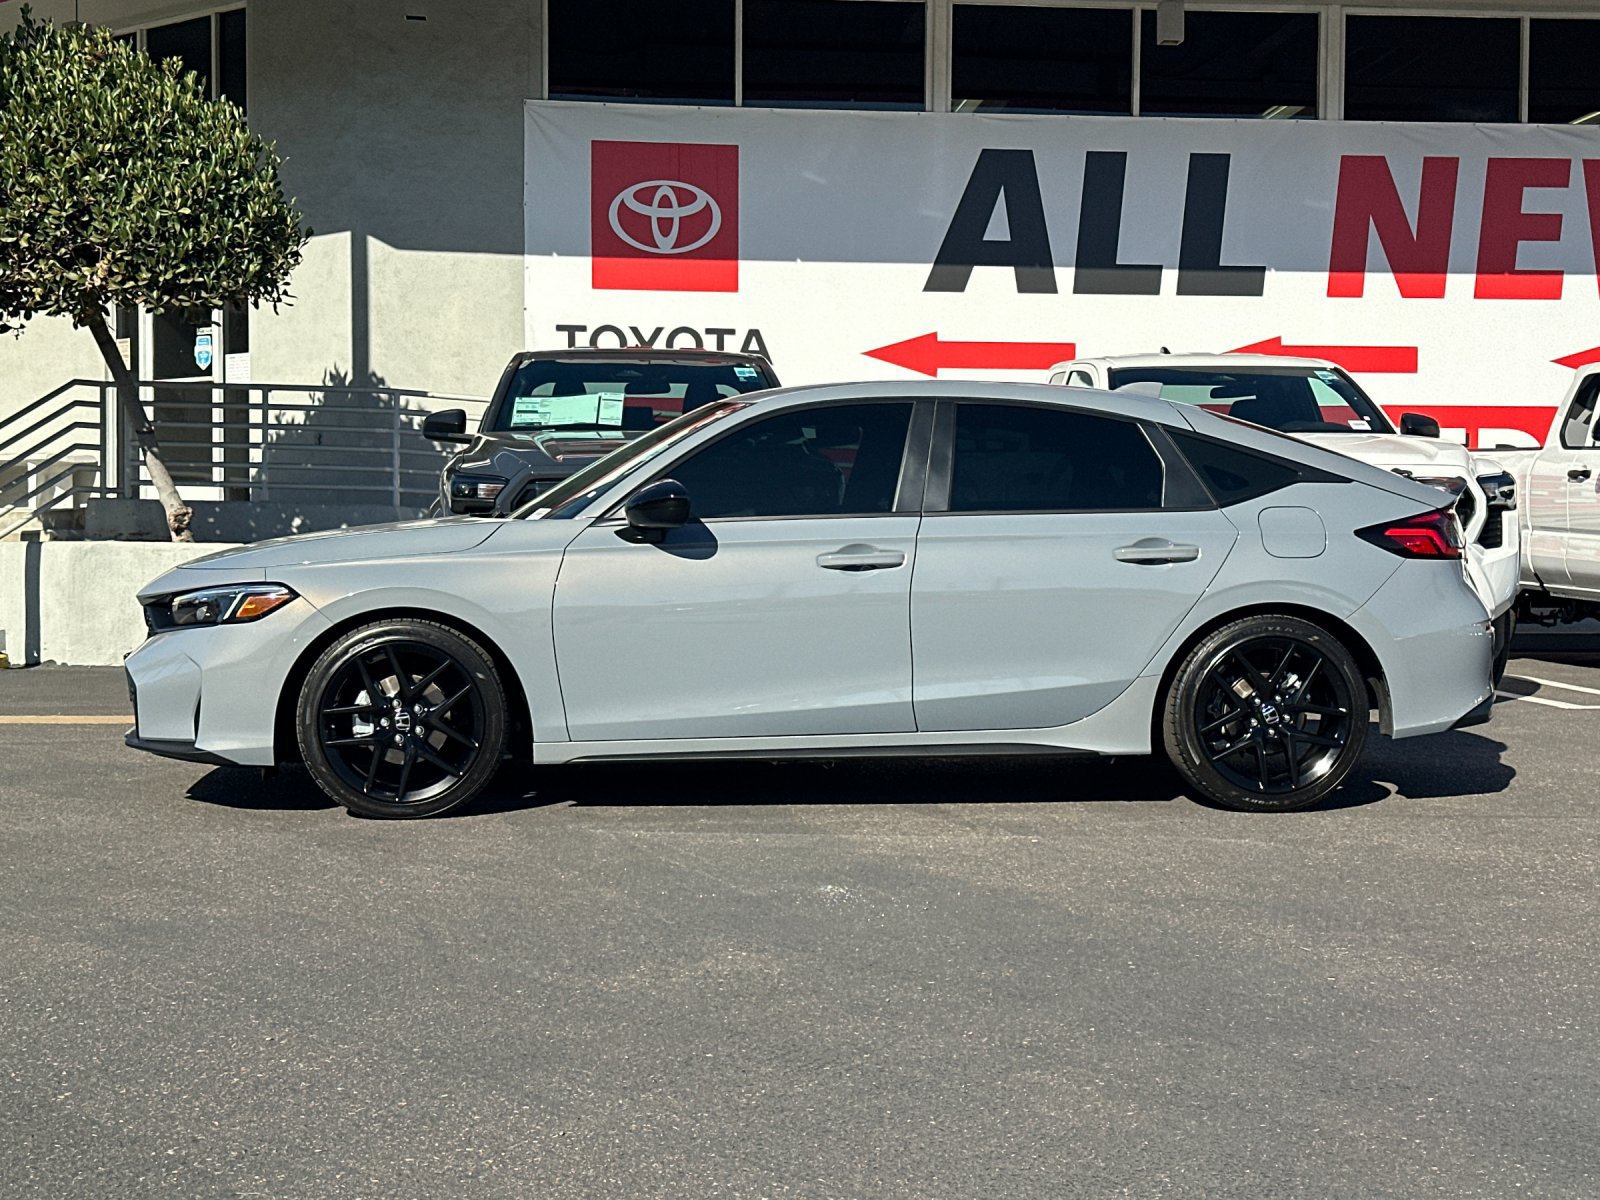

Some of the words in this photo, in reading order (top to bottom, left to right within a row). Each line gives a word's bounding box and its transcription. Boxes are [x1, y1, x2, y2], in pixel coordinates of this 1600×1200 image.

[923, 148, 1266, 297] ALL
[1327, 154, 1600, 301] NE
[556, 324, 773, 365] TOYOTA
